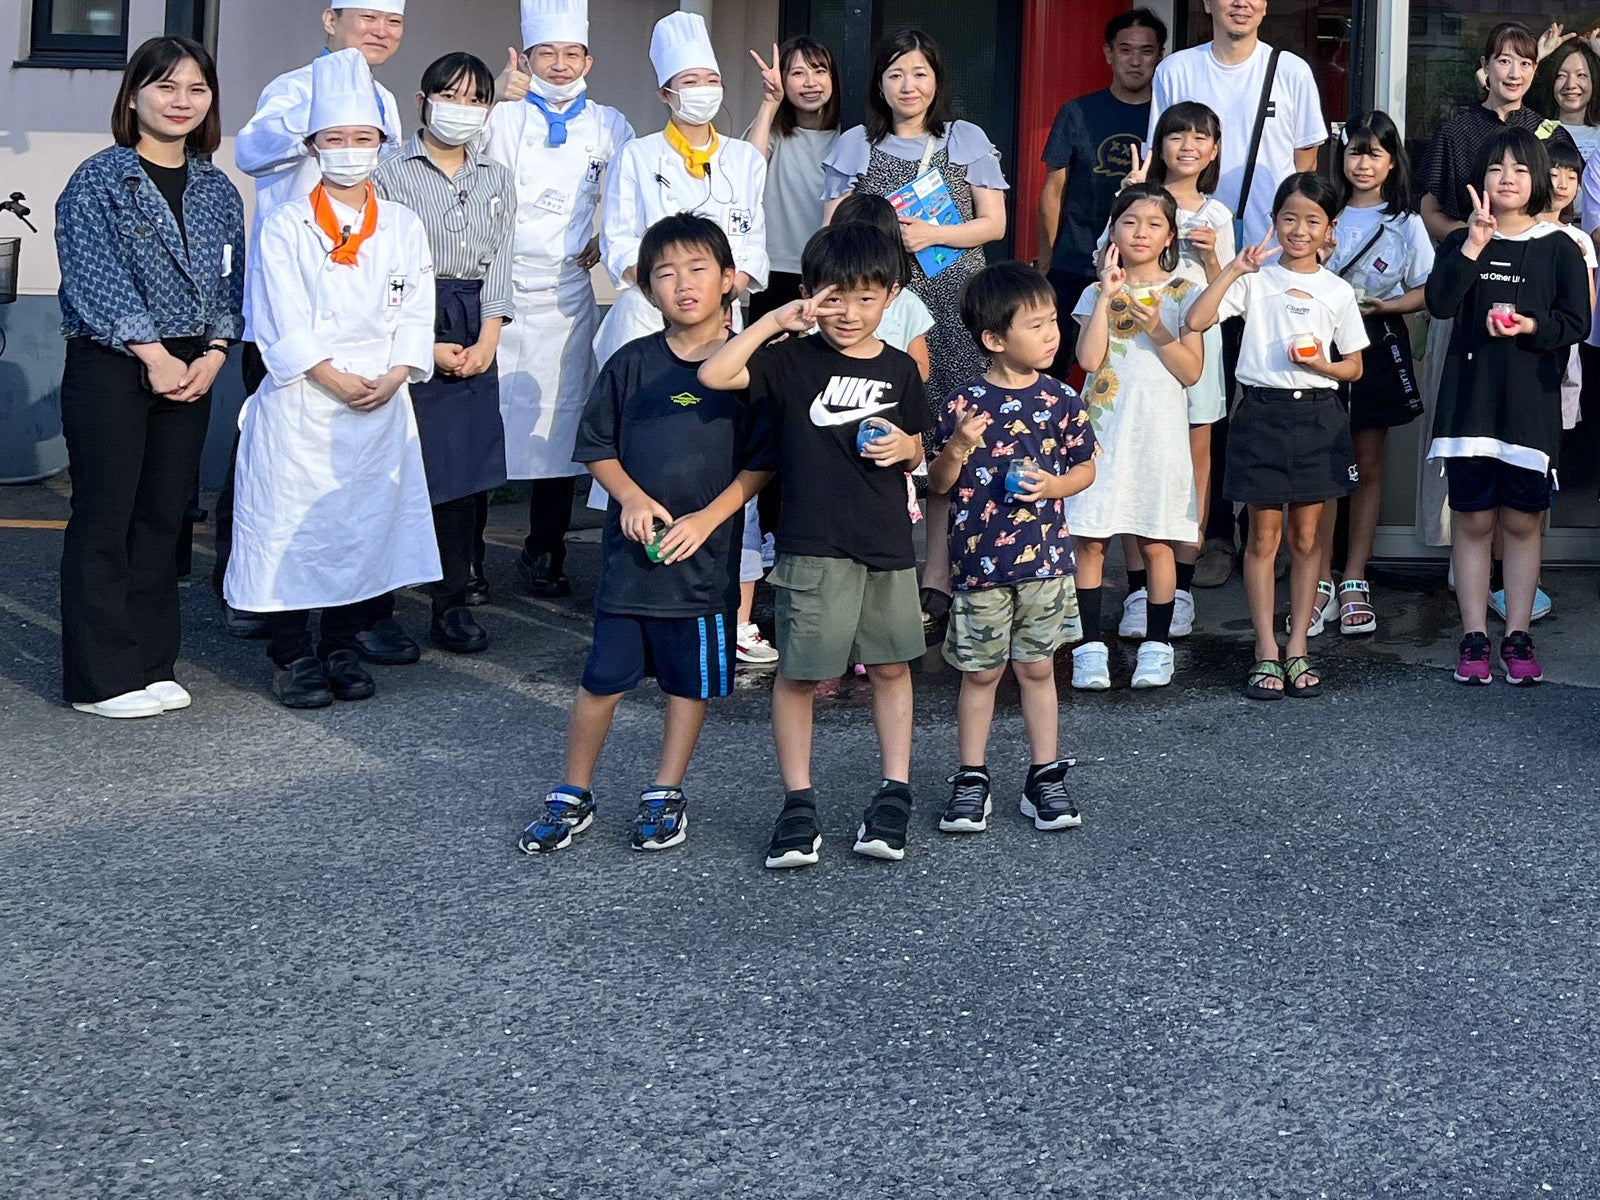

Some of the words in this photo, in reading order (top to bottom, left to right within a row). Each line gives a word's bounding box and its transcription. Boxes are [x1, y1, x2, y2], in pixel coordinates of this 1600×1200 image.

[1489, 272, 1512, 282] Other
[1390, 344, 1403, 364] GIRLS
[821, 375, 887, 407] NIKE
